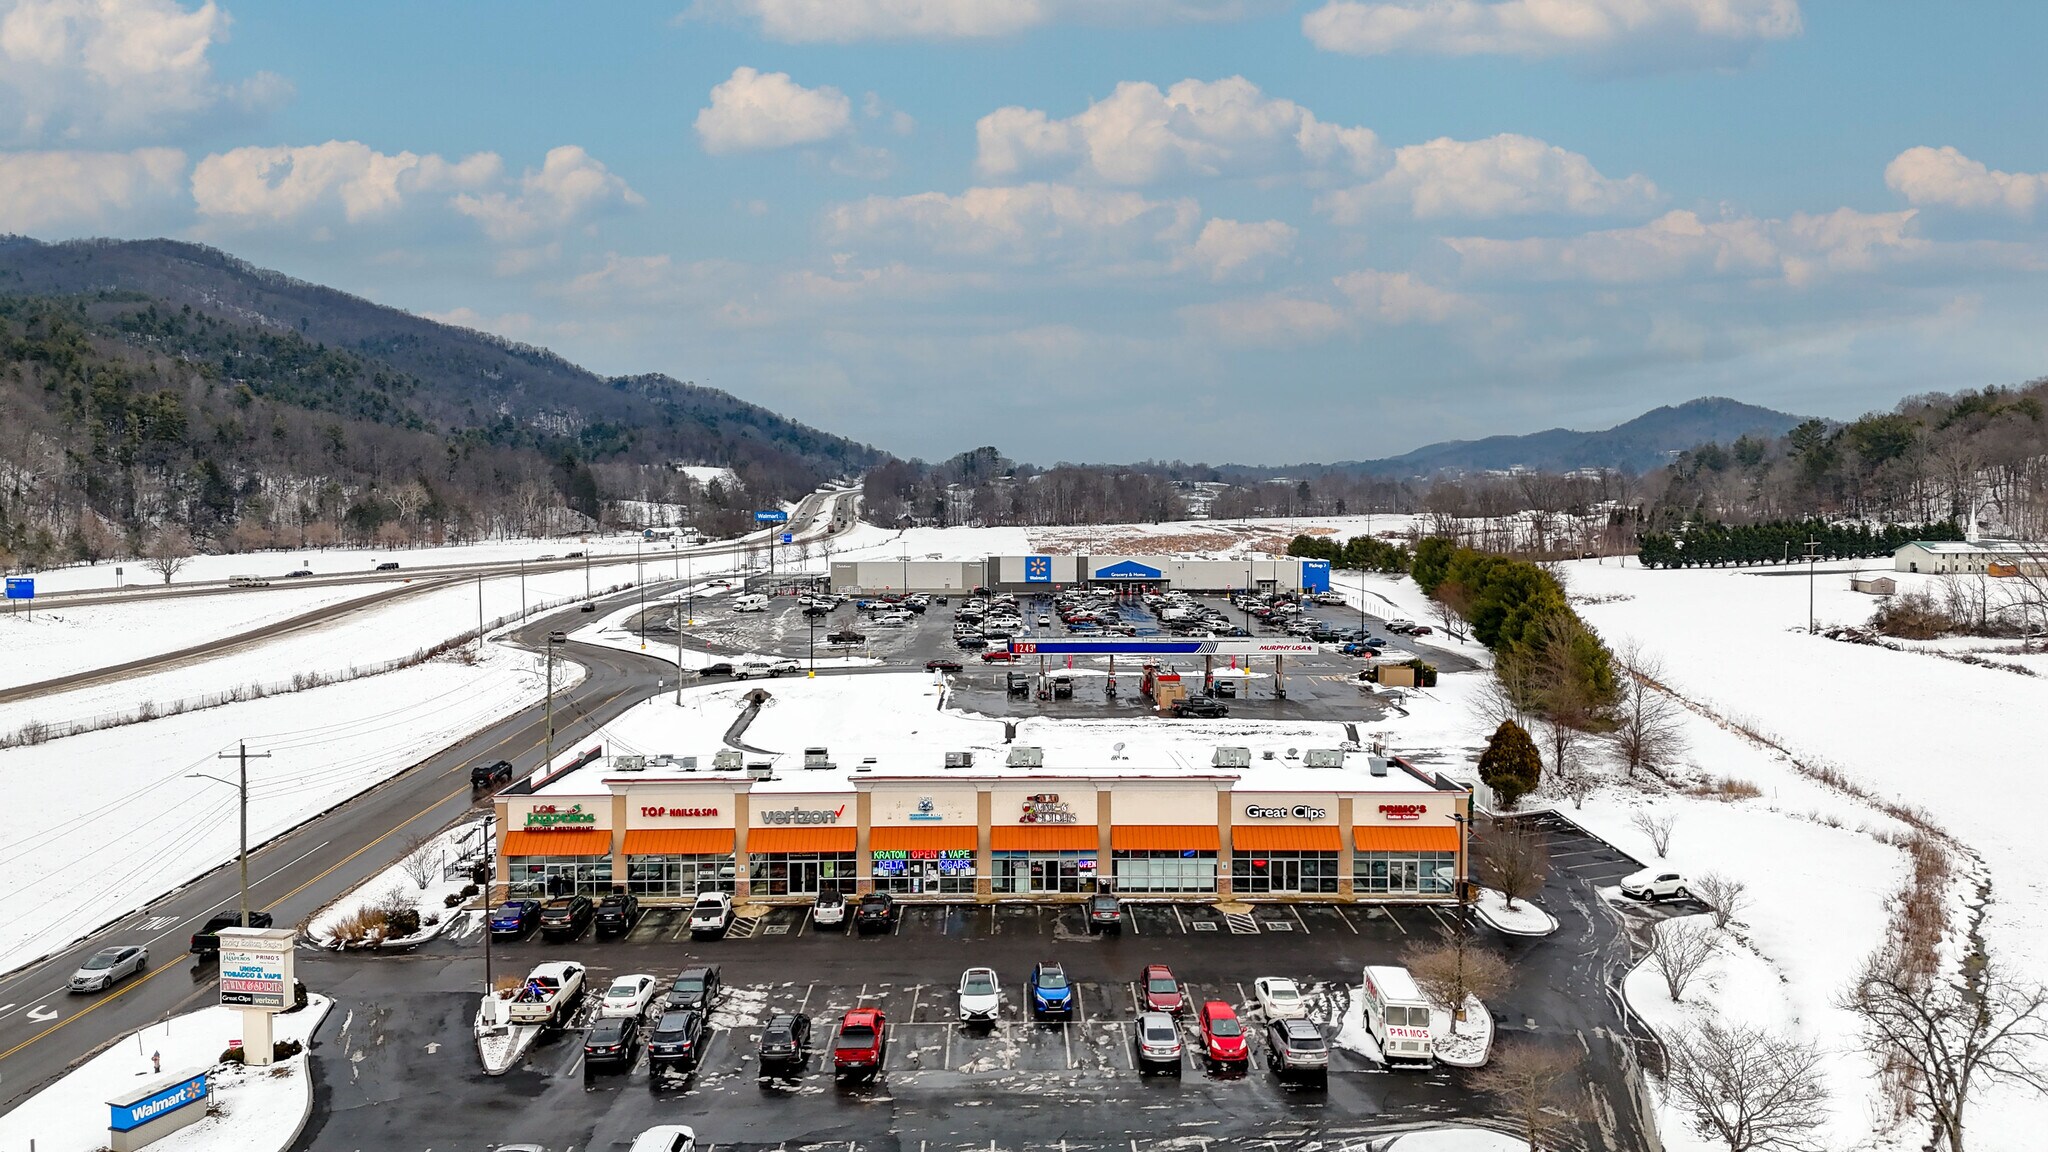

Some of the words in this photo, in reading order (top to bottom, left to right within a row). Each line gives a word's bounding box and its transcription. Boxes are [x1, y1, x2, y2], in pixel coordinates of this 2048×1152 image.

[533, 804, 556, 813] LOS
[641, 806, 666, 817] TOP
[1246, 804, 1288, 818] Great
[1292, 804, 1326, 821] Clips
[1378, 805, 1427, 814] PRIMO'S
[760, 806, 836, 825] verizon
[873, 850, 907, 859] KRATOM
[911, 850, 938, 859] OPEN
[947, 850, 971, 859] VAPE
[878, 860, 904, 869] DELTA
[940, 860, 970, 869] CIGARS
[1079, 860, 1097, 868] OPEN
[223, 971, 255, 979] TOBACCO
[230, 980, 247, 990] WINE
[254, 981, 283, 992] SPIRITS
[238, 995, 252, 1003] Clips
[254, 997, 280, 1005] verizon
[1389, 1027, 1429, 1038] PRIMOS
[131, 1088, 186, 1122] Walmart
